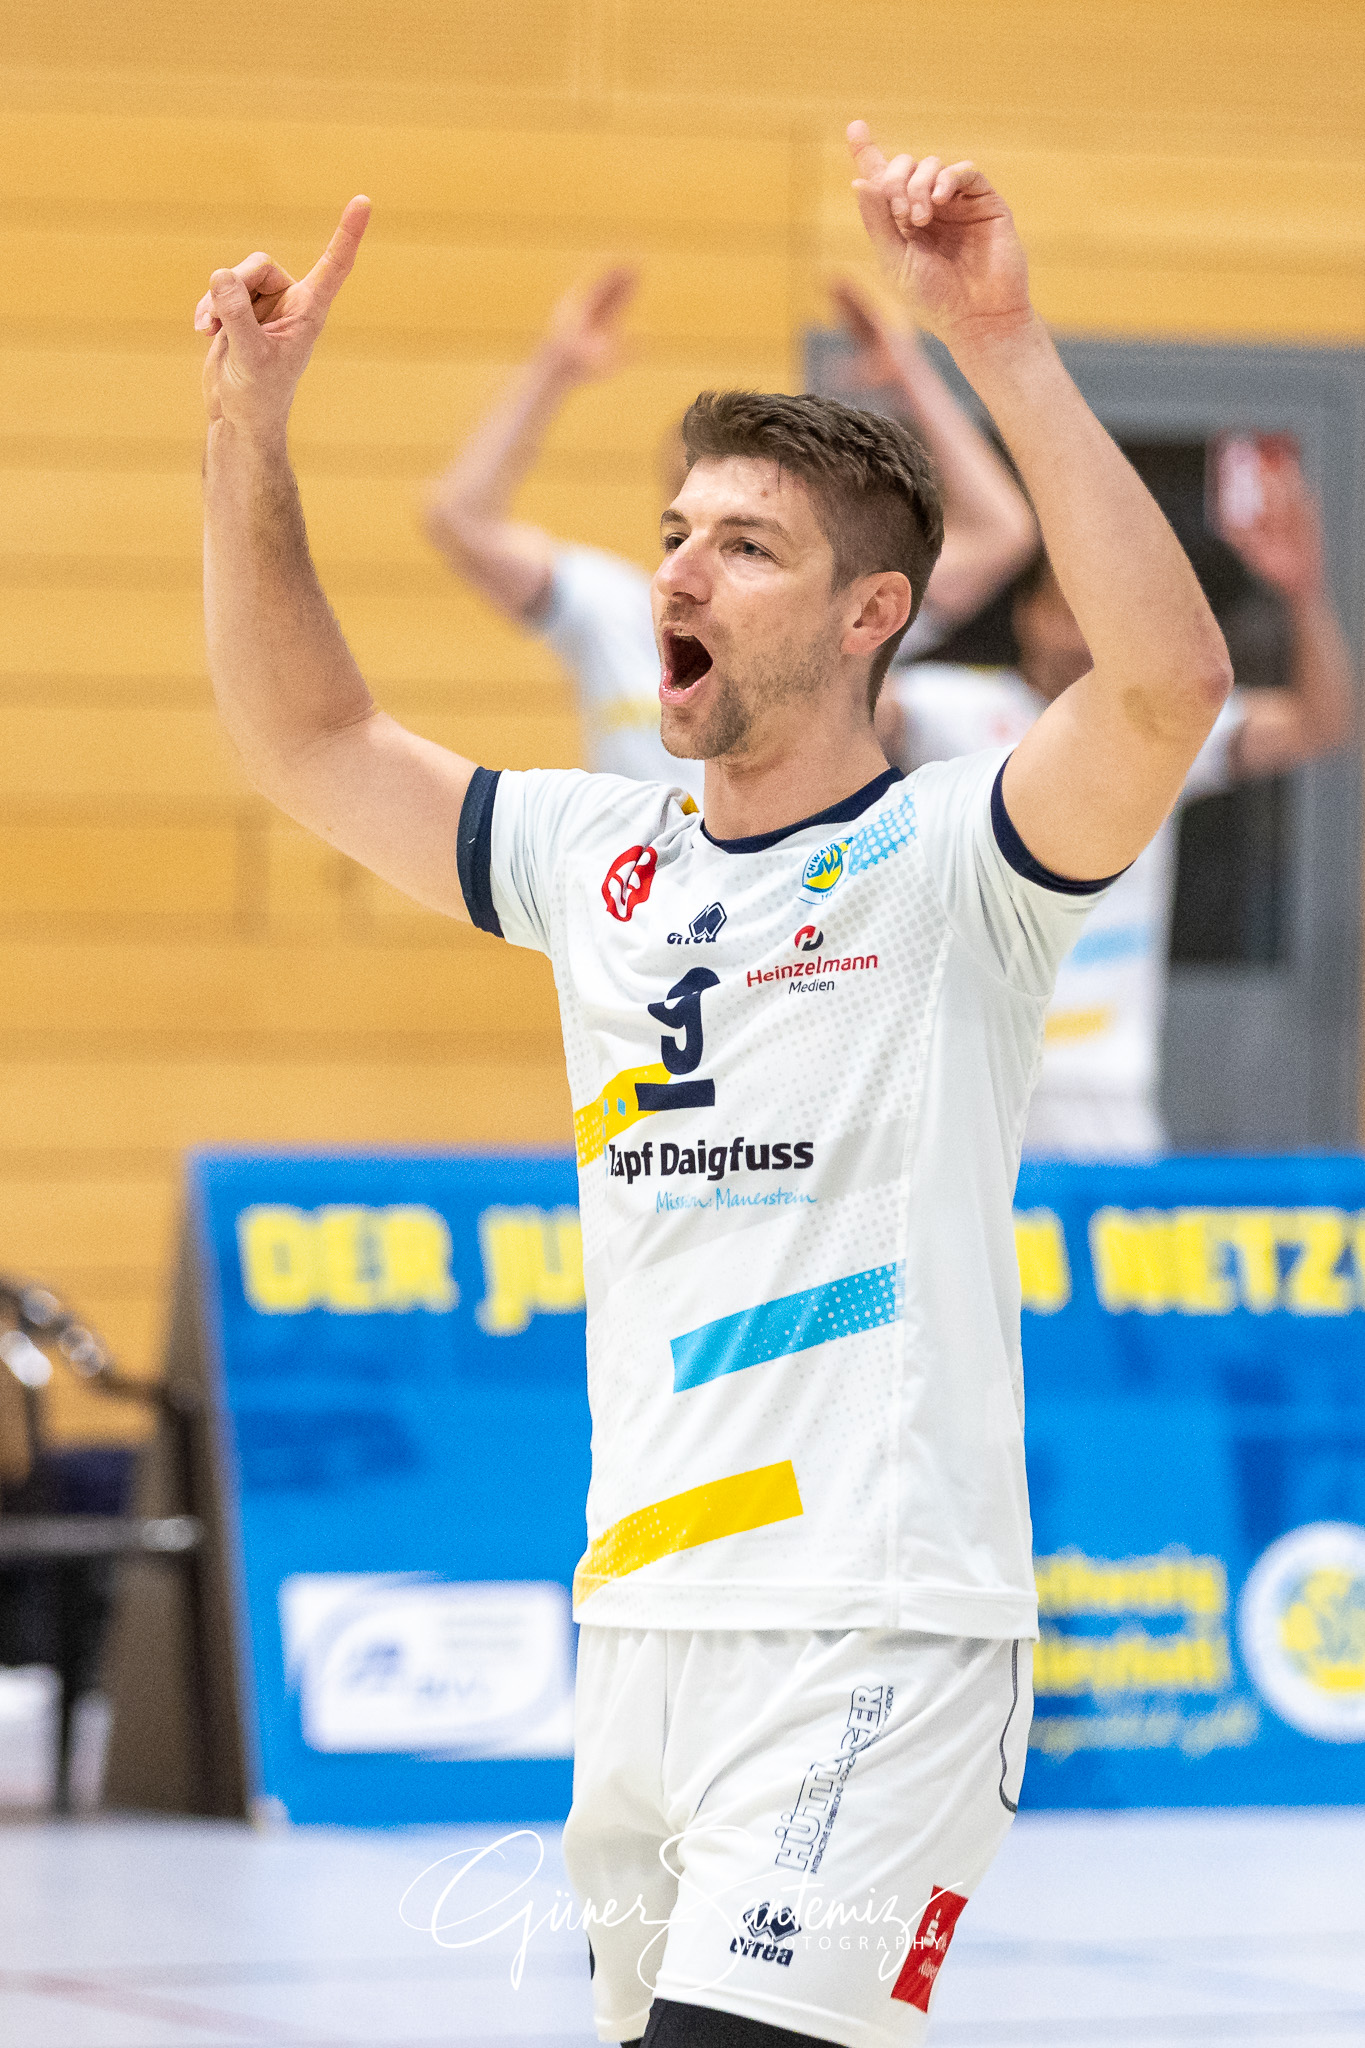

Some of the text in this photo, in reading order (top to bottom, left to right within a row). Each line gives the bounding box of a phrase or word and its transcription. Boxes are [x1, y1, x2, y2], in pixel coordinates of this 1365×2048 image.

[747, 955, 878, 988] Heinzelmann
[788, 979, 835, 995] Medien
[660, 1136, 814, 1181] Daigfuss
[238, 1204, 460, 1314] DER
[730, 1936, 794, 1967] errea
